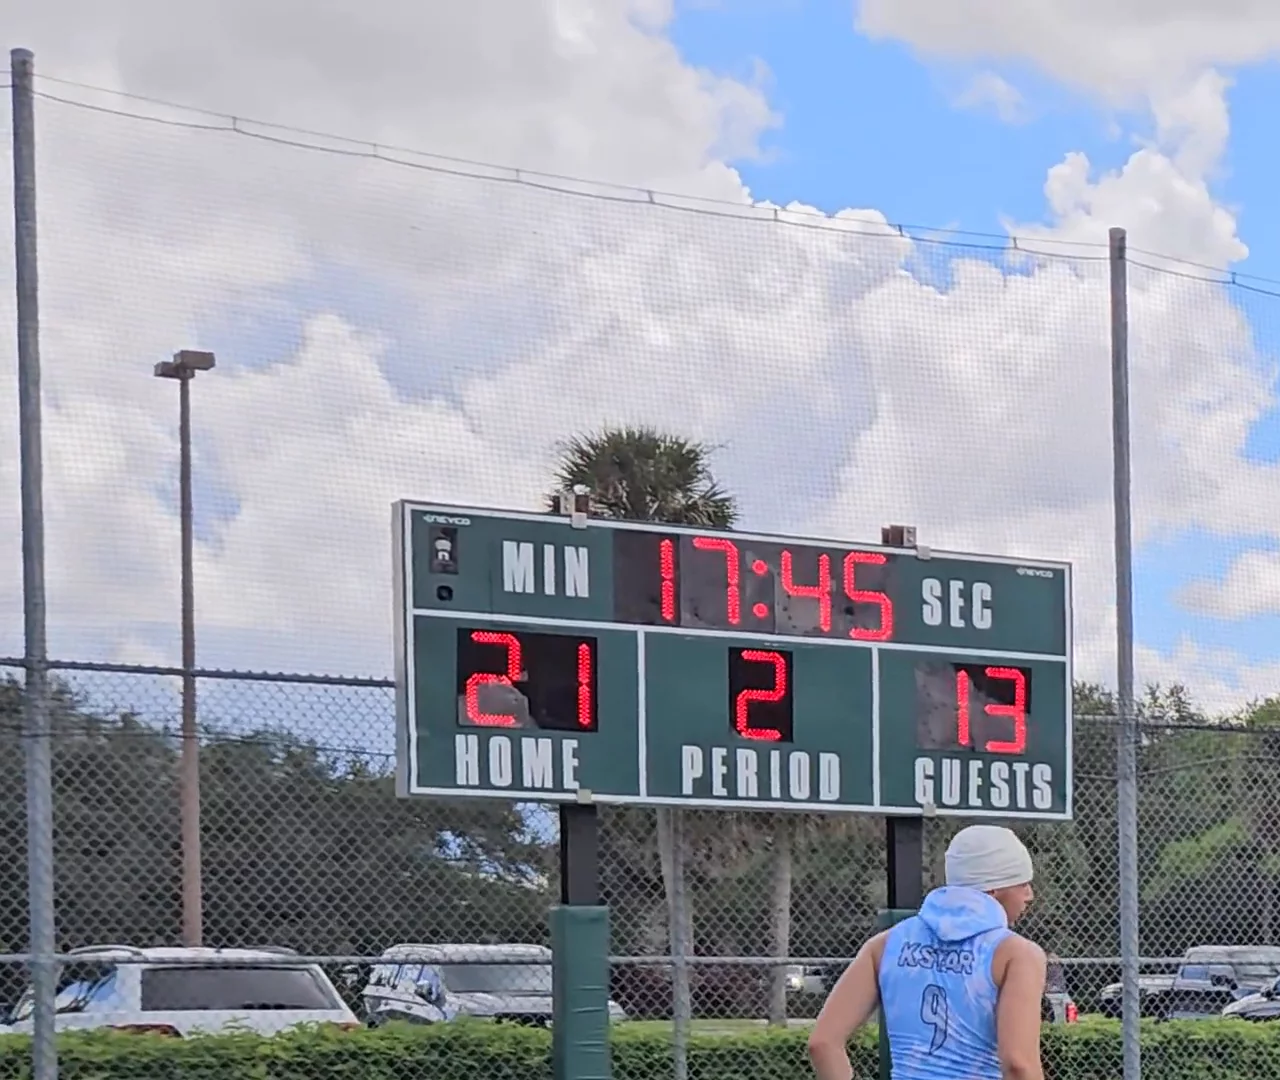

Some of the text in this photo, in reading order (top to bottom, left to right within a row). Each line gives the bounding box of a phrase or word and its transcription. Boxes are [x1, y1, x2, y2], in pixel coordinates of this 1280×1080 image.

[502, 540, 589, 598] MIN
[660, 537, 893, 640] 17:45
[921, 577, 993, 630] SEC
[465, 631, 591, 726] 21
[735, 649, 787, 742] 2
[956, 667, 1027, 755] 13
[455, 734, 580, 790] HOME
[681, 745, 841, 801] PERIOD
[914, 756, 1053, 810] GUESTS
[920, 984, 948, 1055] 9
